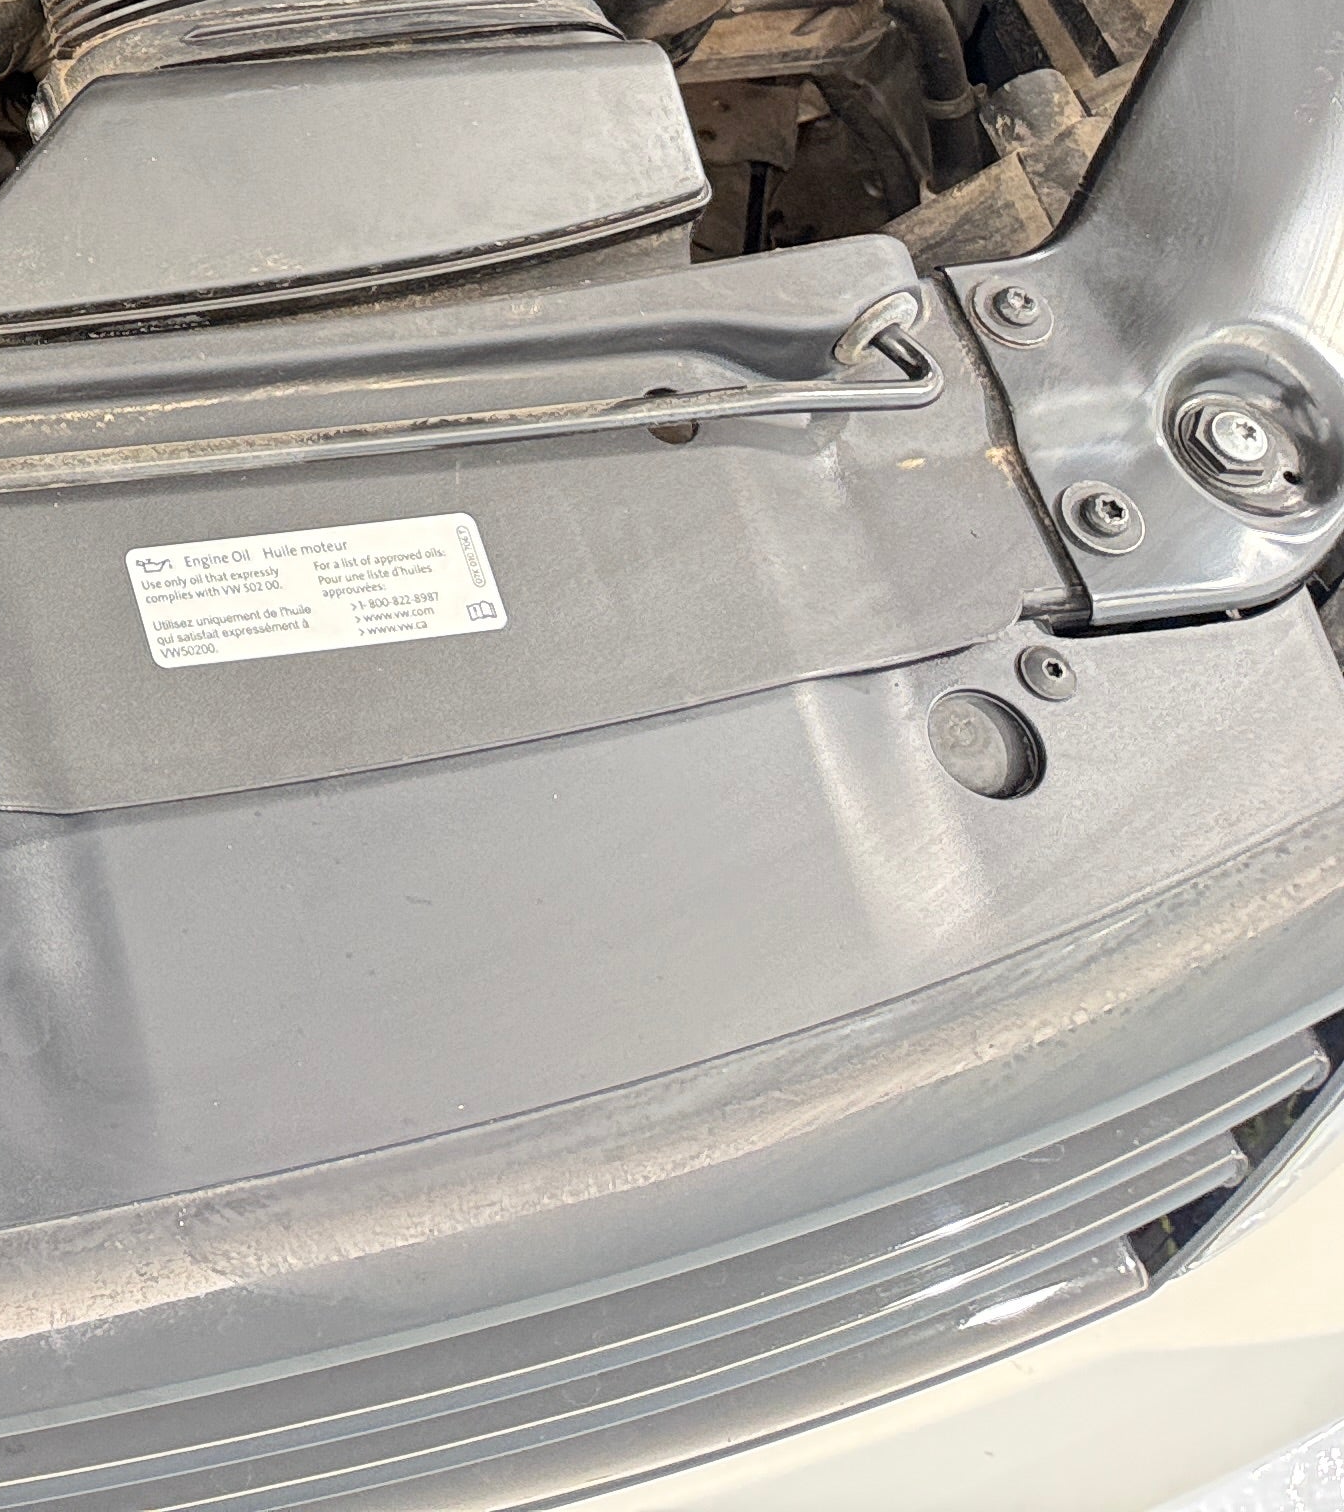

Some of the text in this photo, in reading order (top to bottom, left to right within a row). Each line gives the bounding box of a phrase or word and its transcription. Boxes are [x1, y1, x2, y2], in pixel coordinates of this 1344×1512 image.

[184, 541, 347, 570] Engine Oil Huile moteur
[312, 547, 447, 571] For a list of approved oils:
[140, 566, 279, 591] Use only oil that expressly
[317, 564, 433, 585] Pour une liste d'huiles
[145, 591, 194, 604] complies
[195, 586, 221, 598] with
[220, 584, 241, 596] VW
[243, 581, 264, 593] 502
[152, 604, 312, 632] Utilisez uniquement de l'huile
[363, 607, 435, 622] www.vw.com
[367, 620, 428, 635] www.vw.ca
